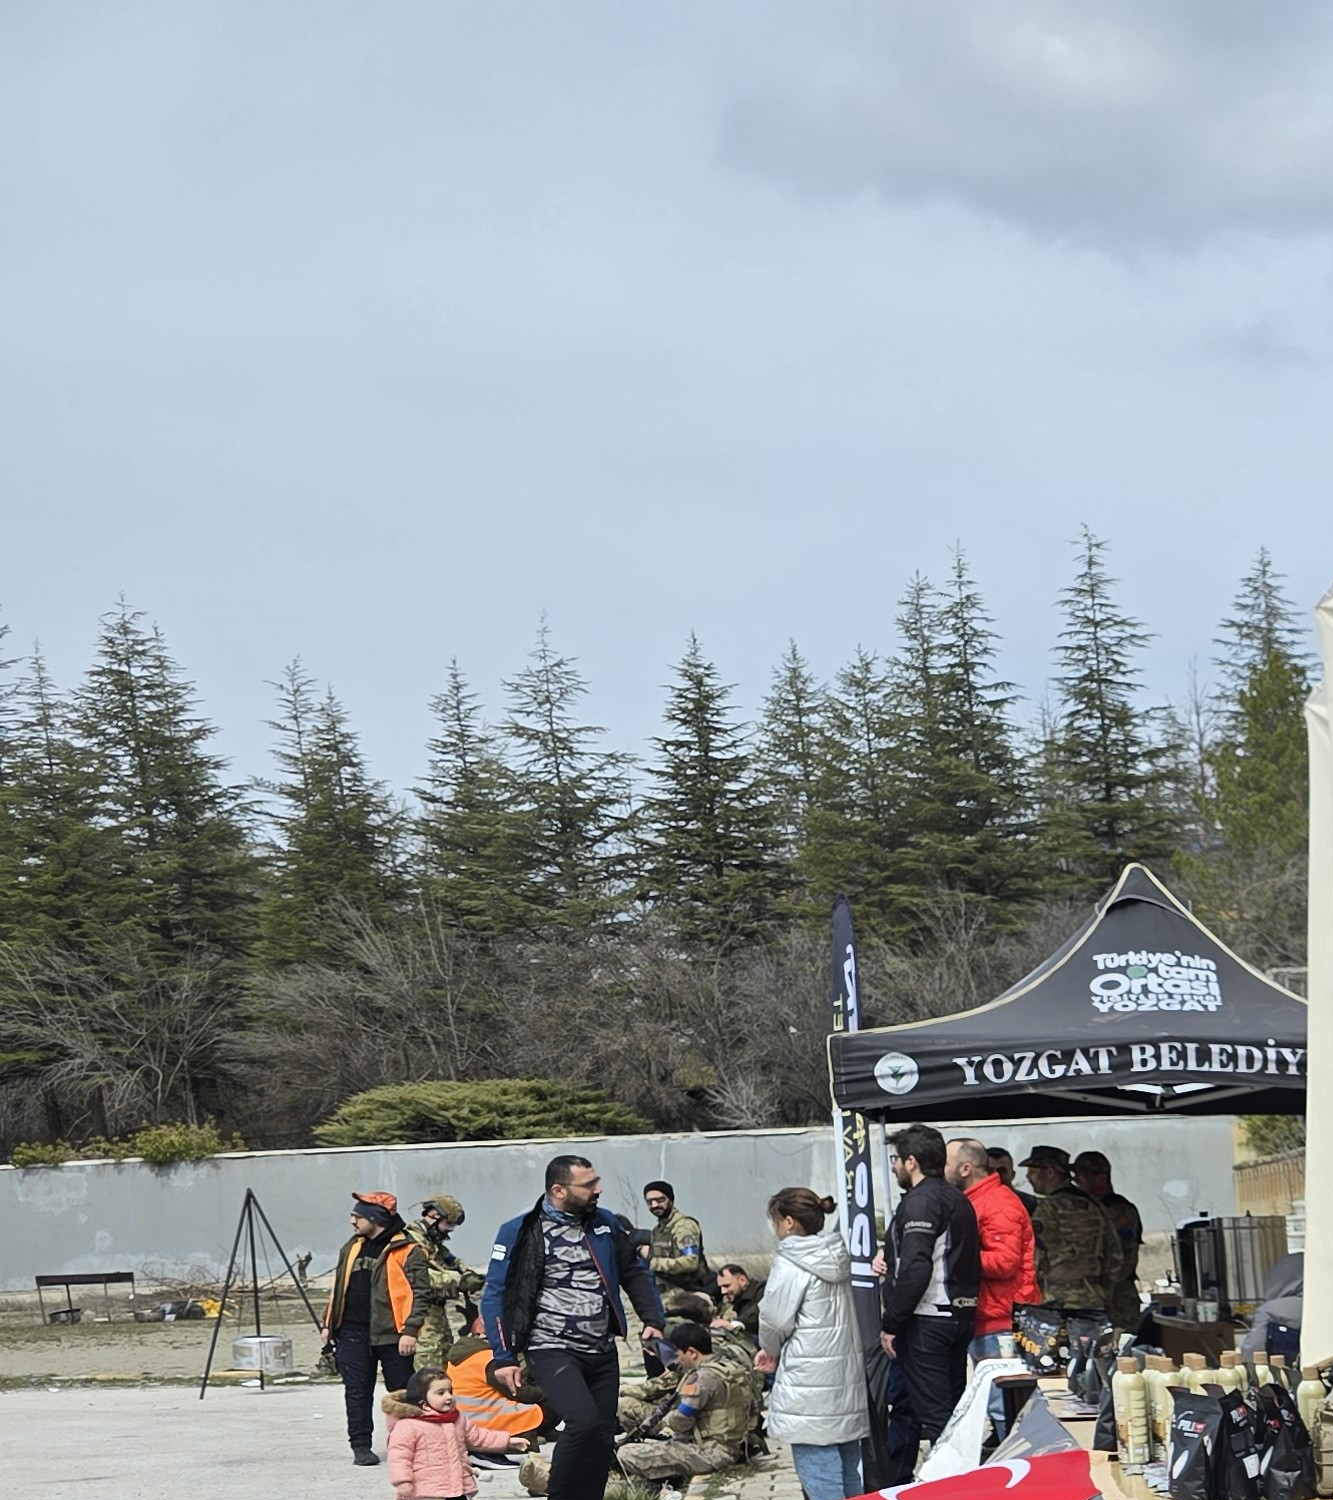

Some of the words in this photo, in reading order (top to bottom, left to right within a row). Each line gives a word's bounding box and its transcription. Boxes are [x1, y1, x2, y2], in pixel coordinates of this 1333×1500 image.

[1092, 950, 1217, 971] Türkiye'nin
[1157, 963, 1218, 982] tam
[1089, 972, 1220, 997] Ortası
[1091, 1001, 1218, 1013] YOZGAT
[953, 1046, 1117, 1086] YOZGAT
[1130, 1037, 1307, 1076] BELEDİY
